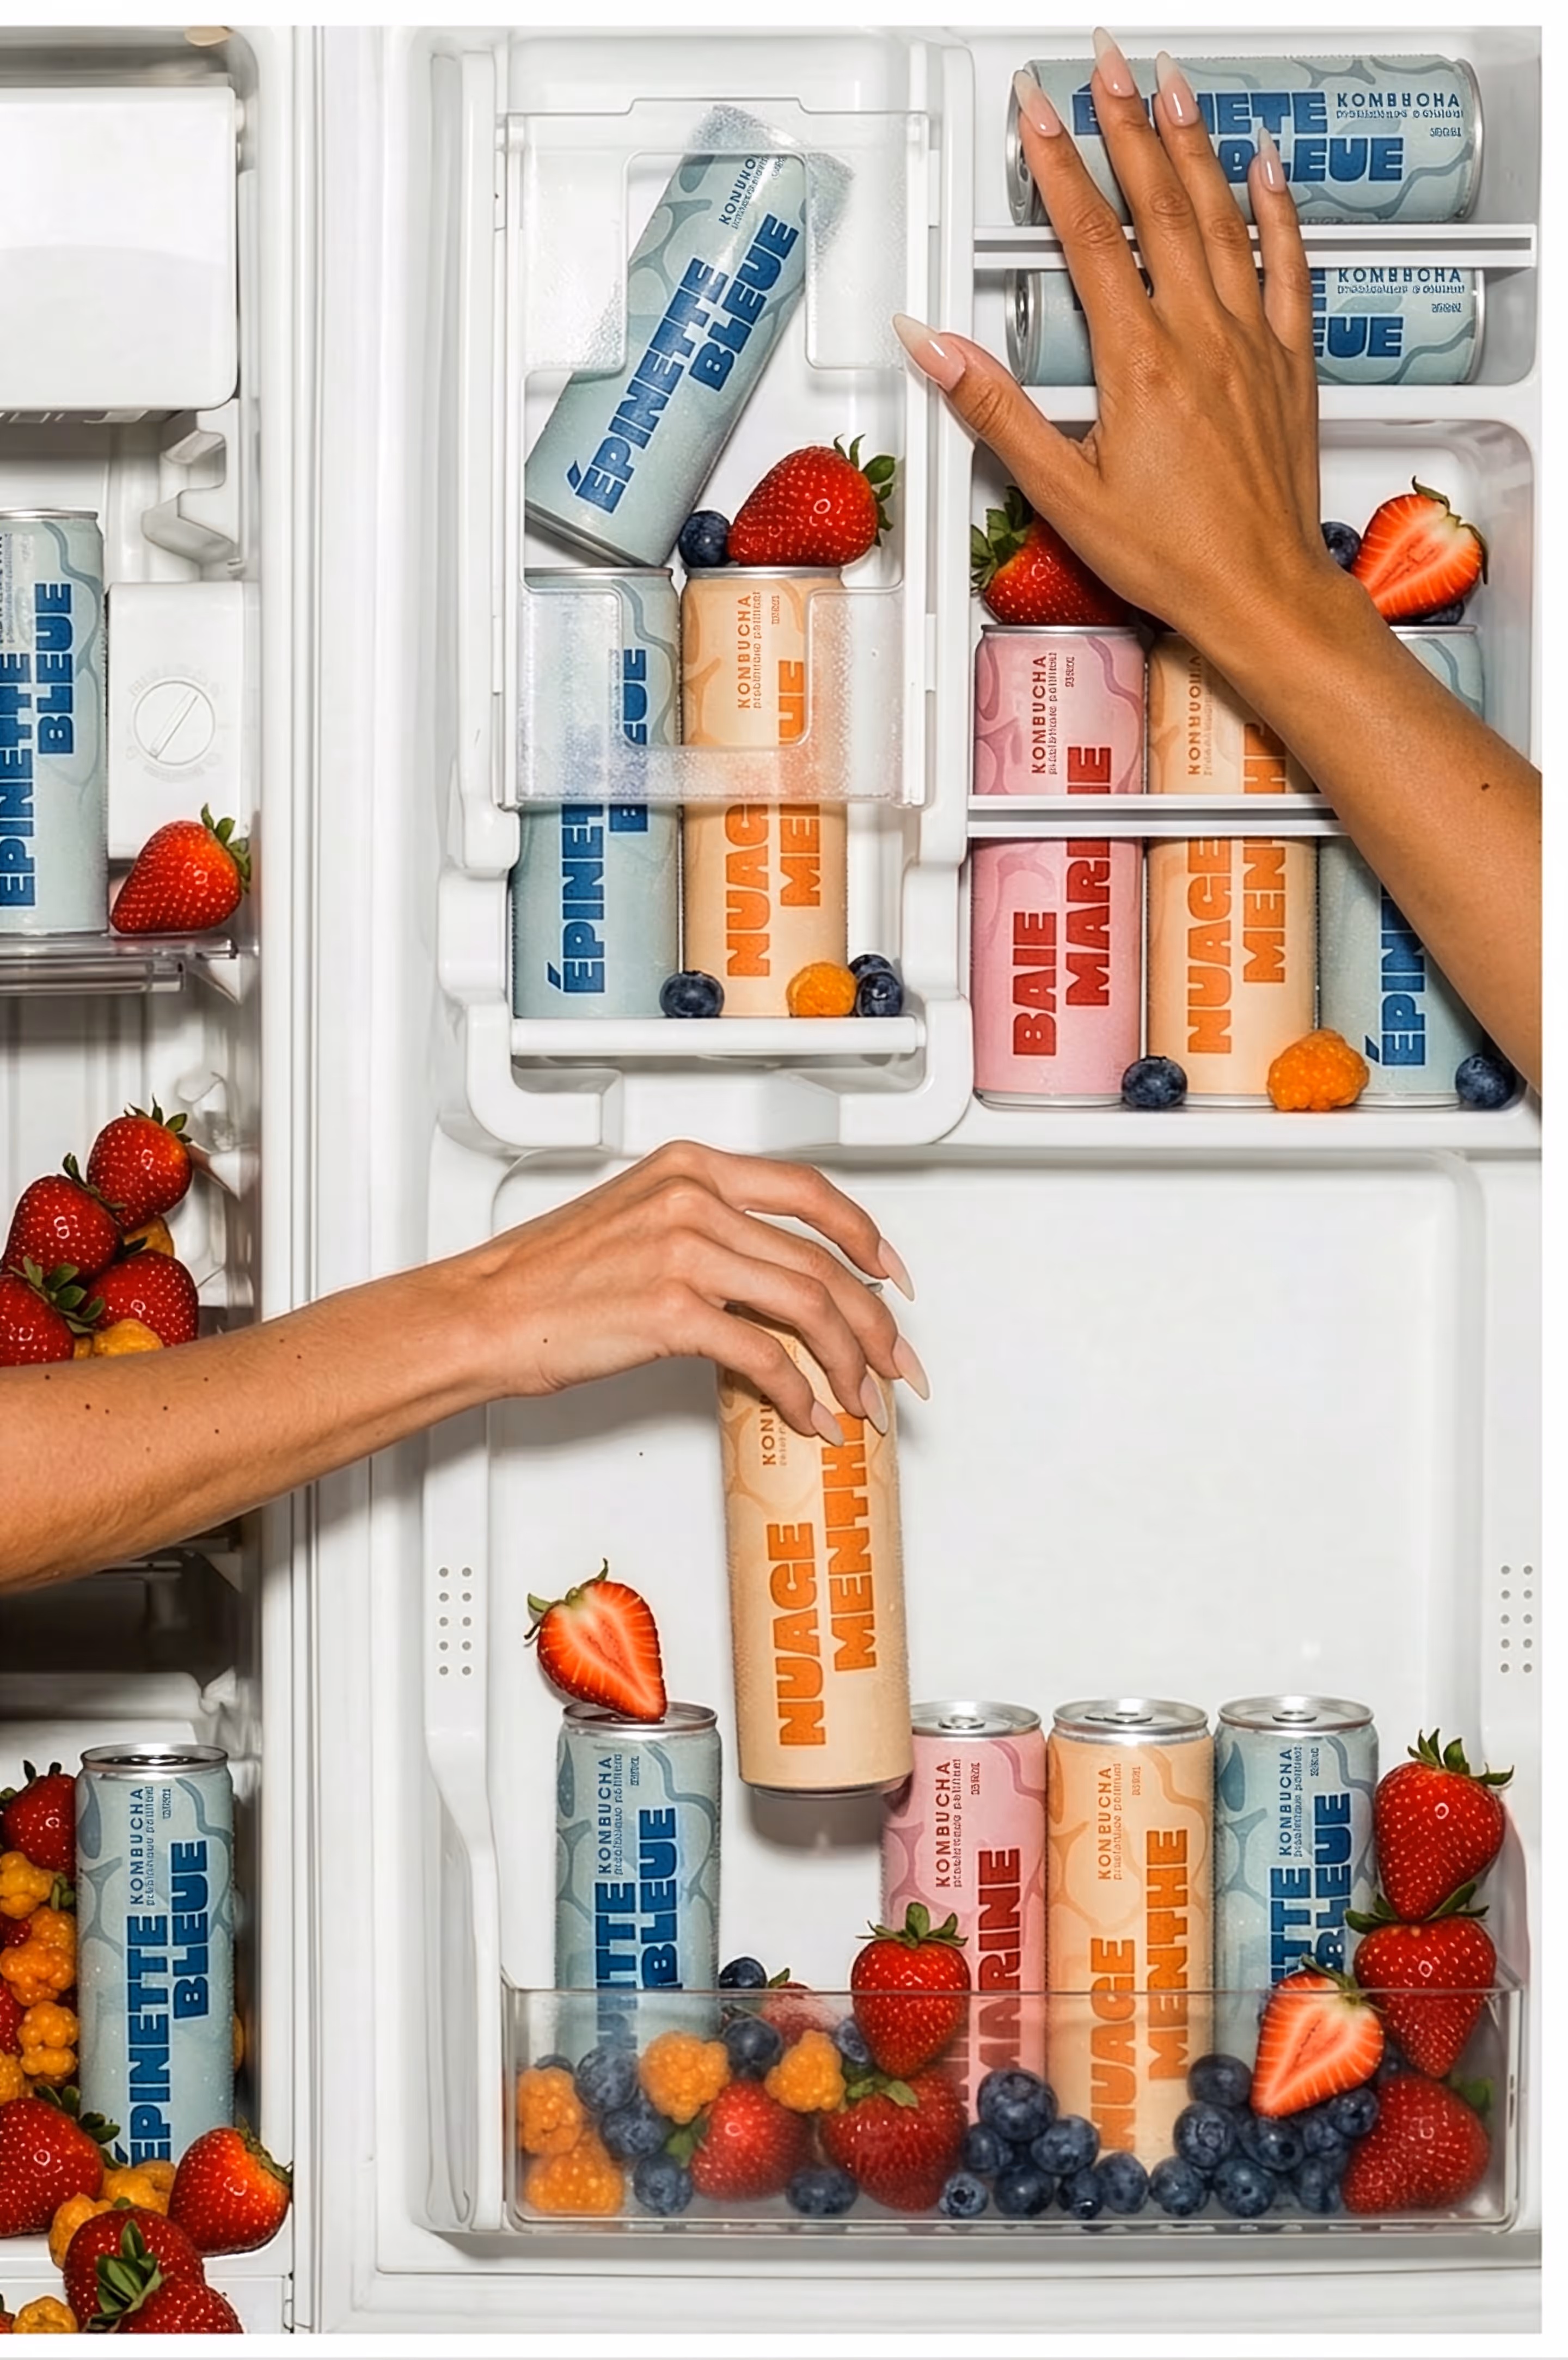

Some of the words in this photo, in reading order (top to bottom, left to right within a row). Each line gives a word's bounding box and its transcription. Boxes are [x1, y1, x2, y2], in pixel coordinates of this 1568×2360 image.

[568, 259, 729, 513] ÉPINETTE
[690, 214, 798, 390] BLEUE
[35, 583, 74, 754] BLEUE
[1032, 655, 1046, 774] KOMBUCHA
[725, 803, 770, 976] NUAG
[1066, 747, 1111, 1006] MARIE
[1187, 837, 1231, 1053] NUAGE
[1013, 912, 1056, 1056] BAIE
[768, 1523, 825, 1746] NUAGE
[130, 1788, 143, 1905] KOMBUCHA
[598, 1756, 612, 1874] KOMBUCHA
[640, 1807, 678, 1989] BLEUE
[936, 1761, 951, 1887] KOMBUCHA
[171, 1840, 209, 2019] BLEUE
[1147, 1829, 1189, 2079] MENTHE
[1091, 1939, 1136, 2151] NUAGE
